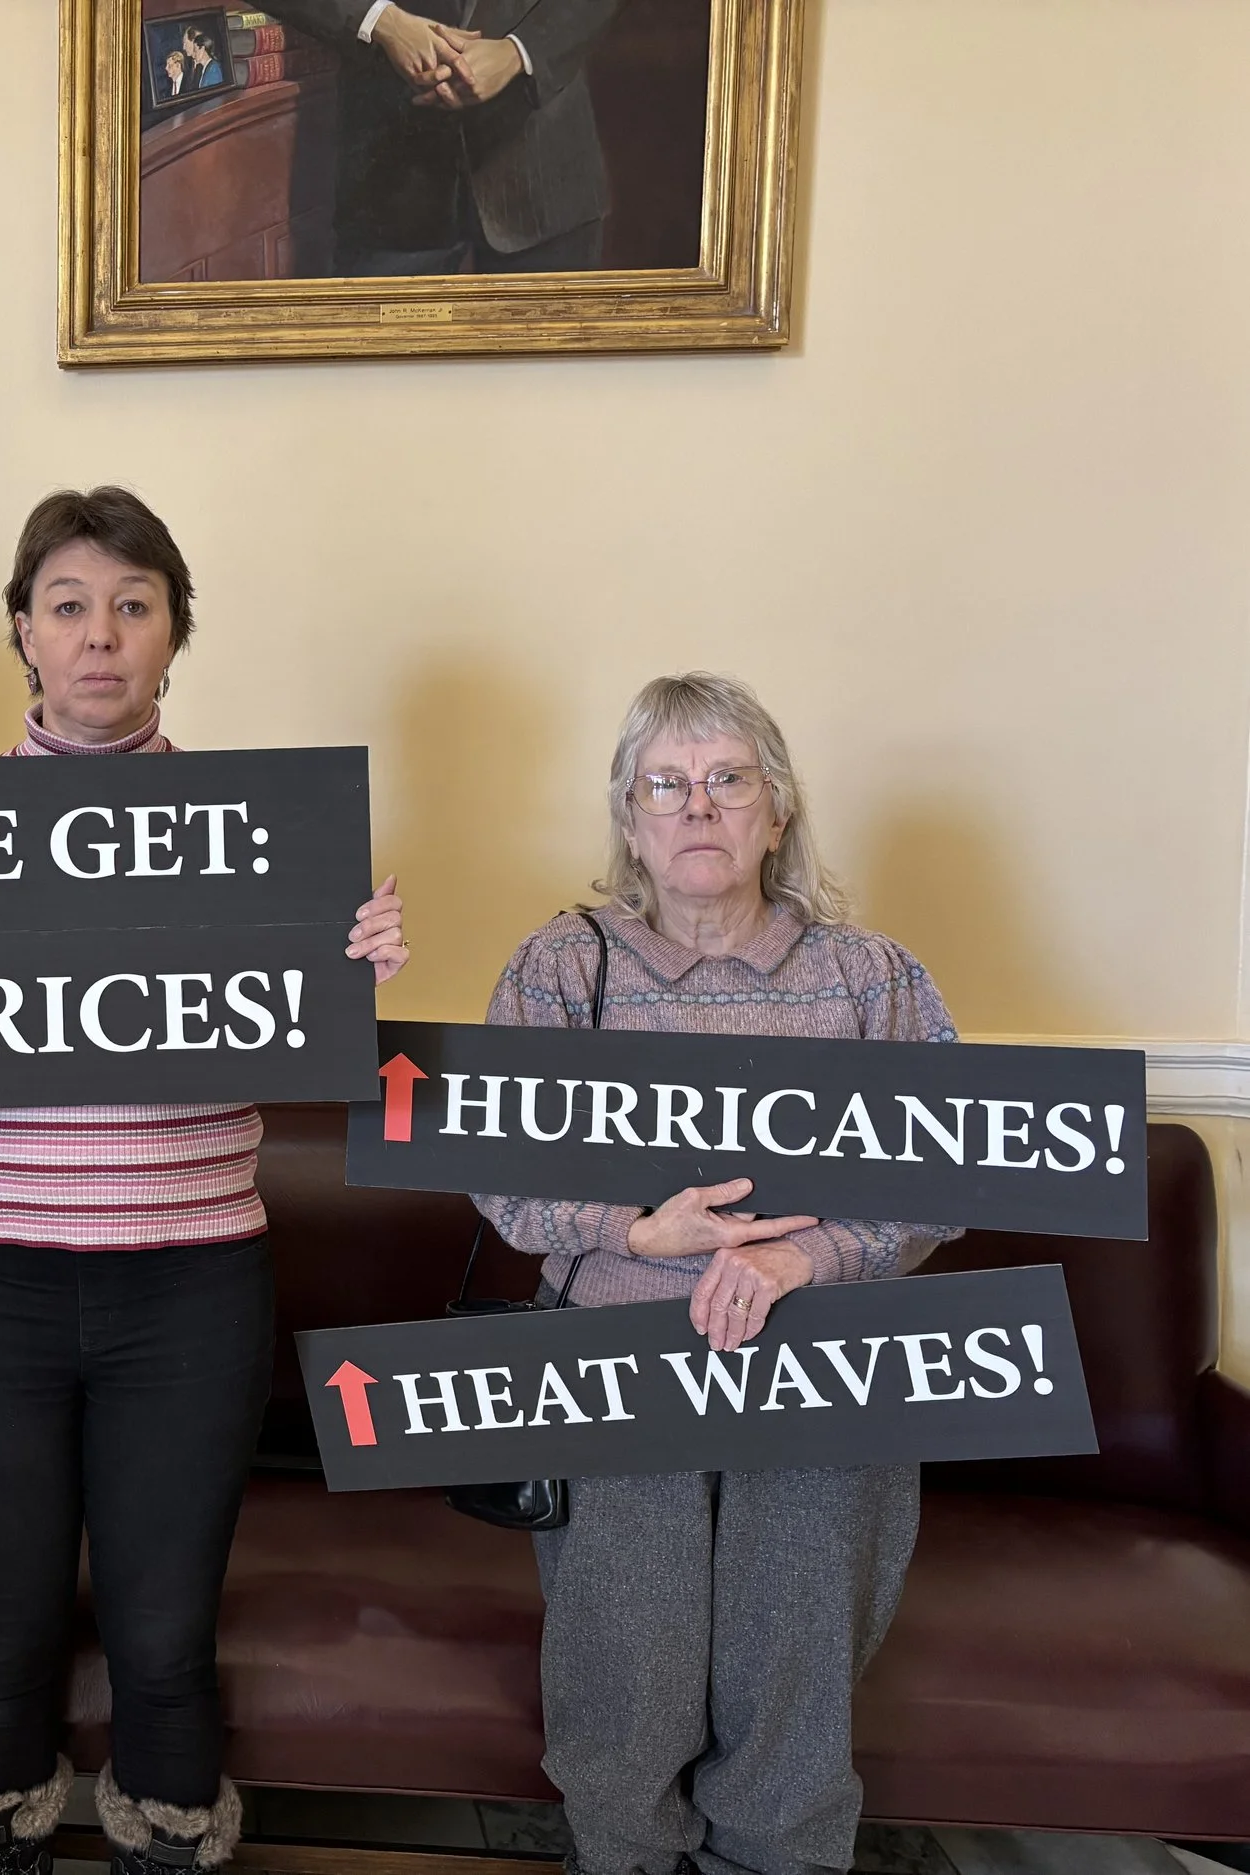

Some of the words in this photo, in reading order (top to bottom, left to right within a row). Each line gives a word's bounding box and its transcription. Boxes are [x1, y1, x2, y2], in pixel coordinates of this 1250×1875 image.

[49, 800, 270, 880] GET:
[438, 1073, 1125, 1175] HURRICANES!
[392, 1353, 639, 1435] HEAT
[659, 1324, 1054, 1416] WAVES!
